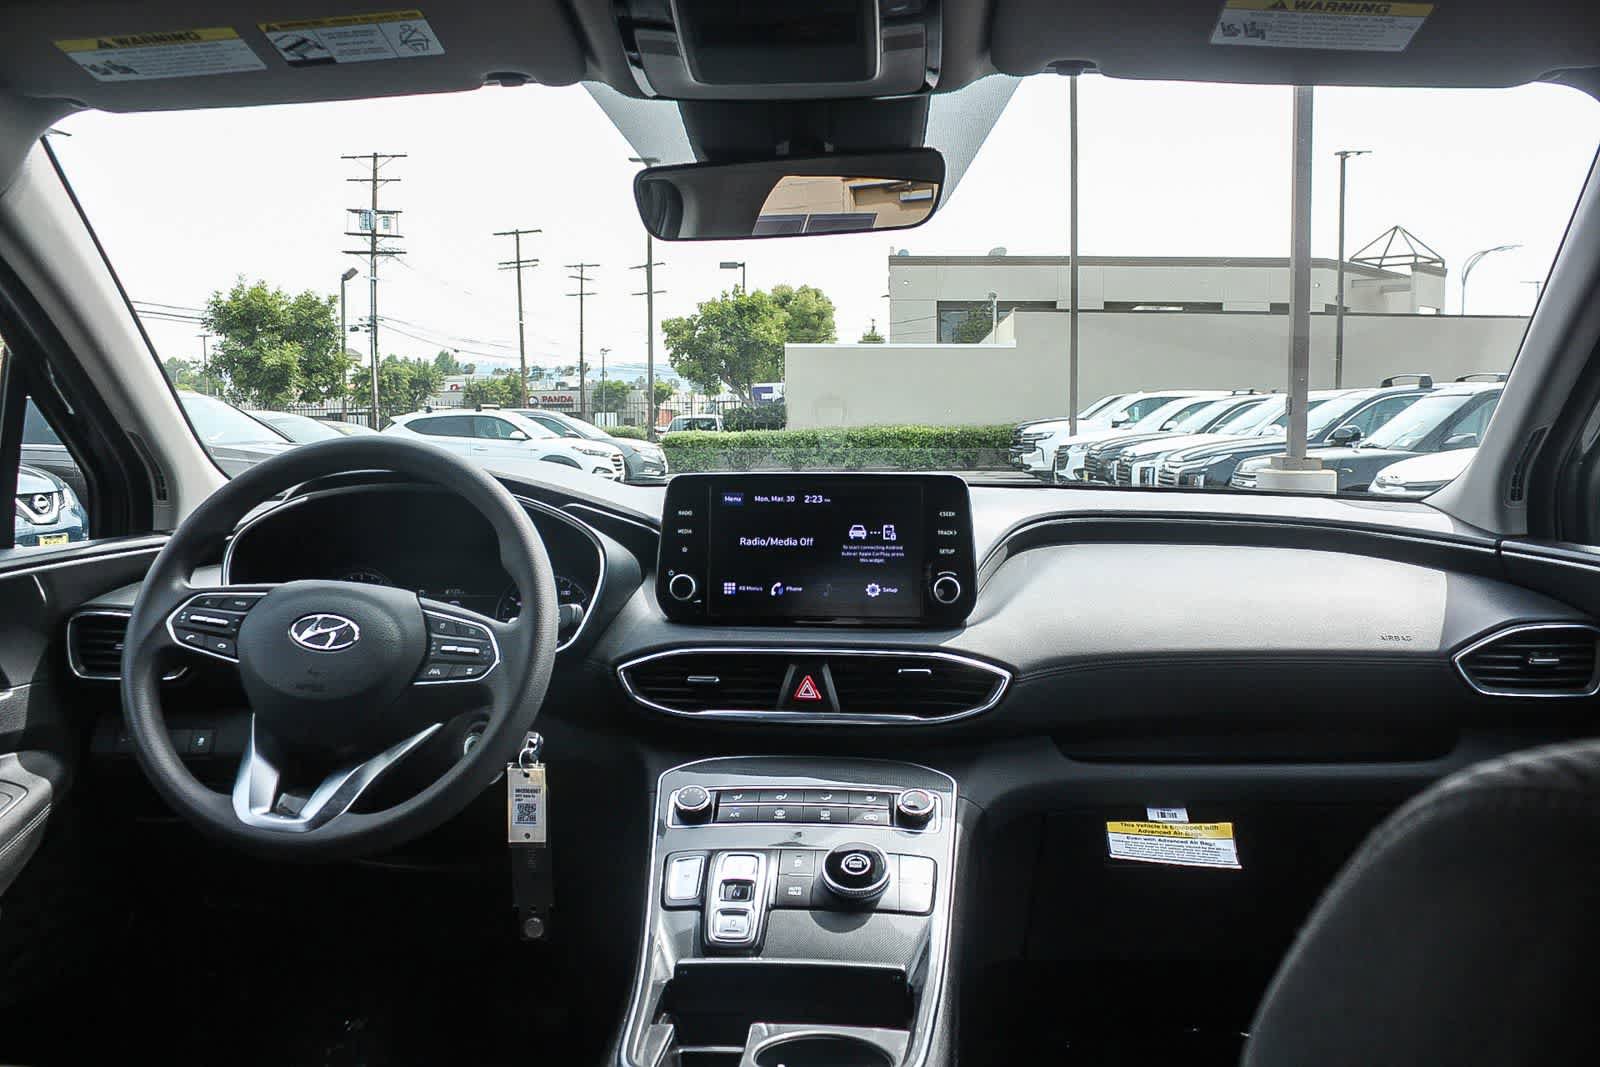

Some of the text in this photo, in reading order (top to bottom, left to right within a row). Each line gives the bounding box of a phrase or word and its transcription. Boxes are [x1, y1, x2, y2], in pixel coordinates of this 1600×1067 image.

[1295, 0, 1392, 14] WARNING
[786, 495, 796, 503] 30
[804, 494, 823, 504] 2:23
[739, 536, 814, 547] Radio/Media Off
